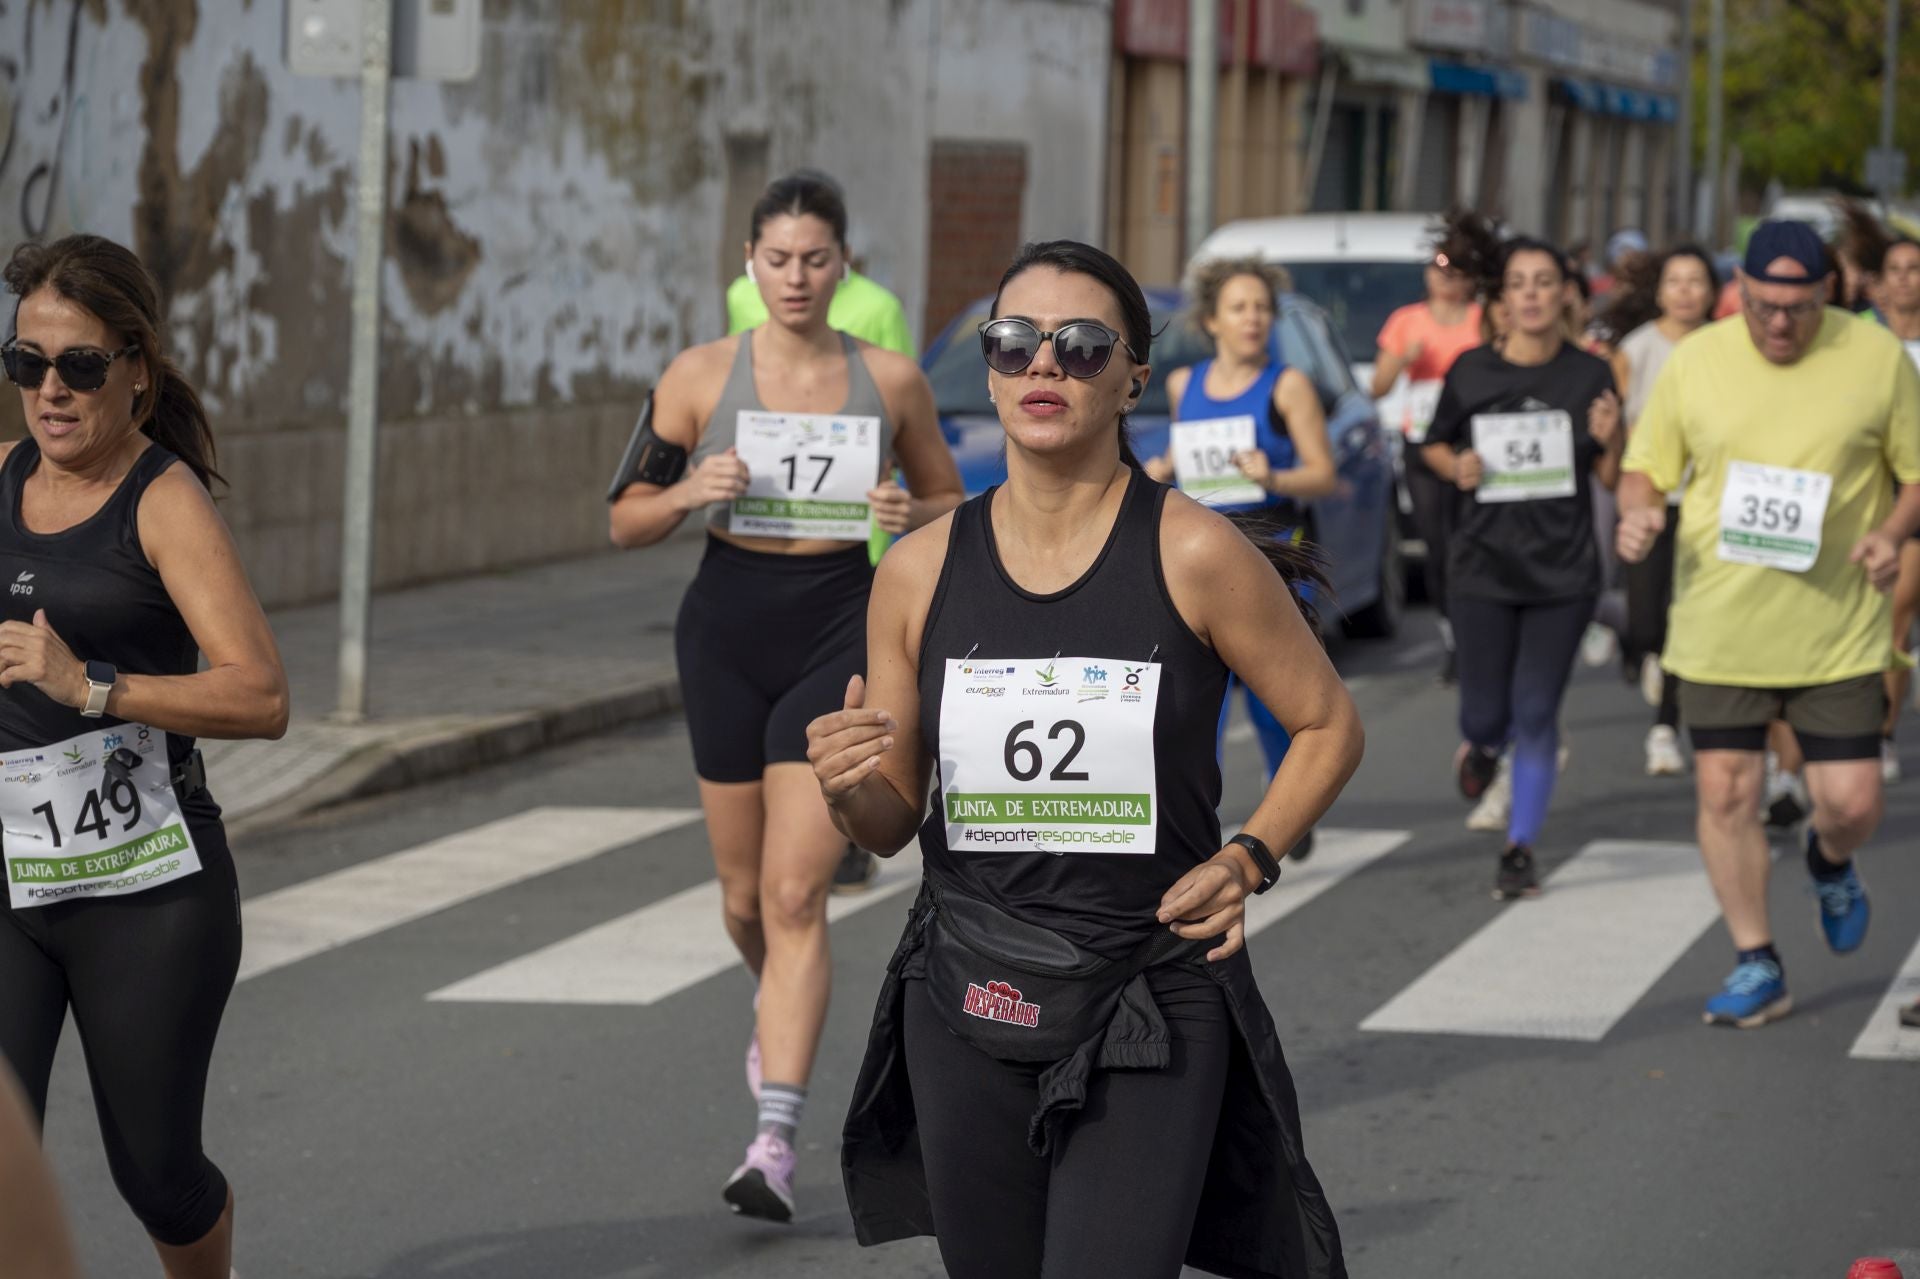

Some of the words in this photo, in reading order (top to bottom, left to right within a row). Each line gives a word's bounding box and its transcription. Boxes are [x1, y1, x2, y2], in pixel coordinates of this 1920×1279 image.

[780, 453, 834, 493] 17
[1505, 440, 1543, 467] 54
[1739, 494, 1802, 532] 359
[1022, 687, 1070, 696] Extremadura
[57, 758, 98, 778] Extremadura
[1004, 719, 1089, 782] 62
[32, 778, 142, 848] 149
[952, 800, 998, 819] JUNTA
[1006, 800, 1024, 817] DE
[1032, 800, 1145, 818] EXTREMADURA
[14, 862, 55, 879] JUNTA
[61, 861, 80, 876] DE
[86, 832, 182, 874] EXTREMADURA
[964, 828, 1136, 844] #deporteresponsable
[27, 858, 181, 899] #deporteresponsable
[964, 984, 1040, 1027] DESPERADOS
